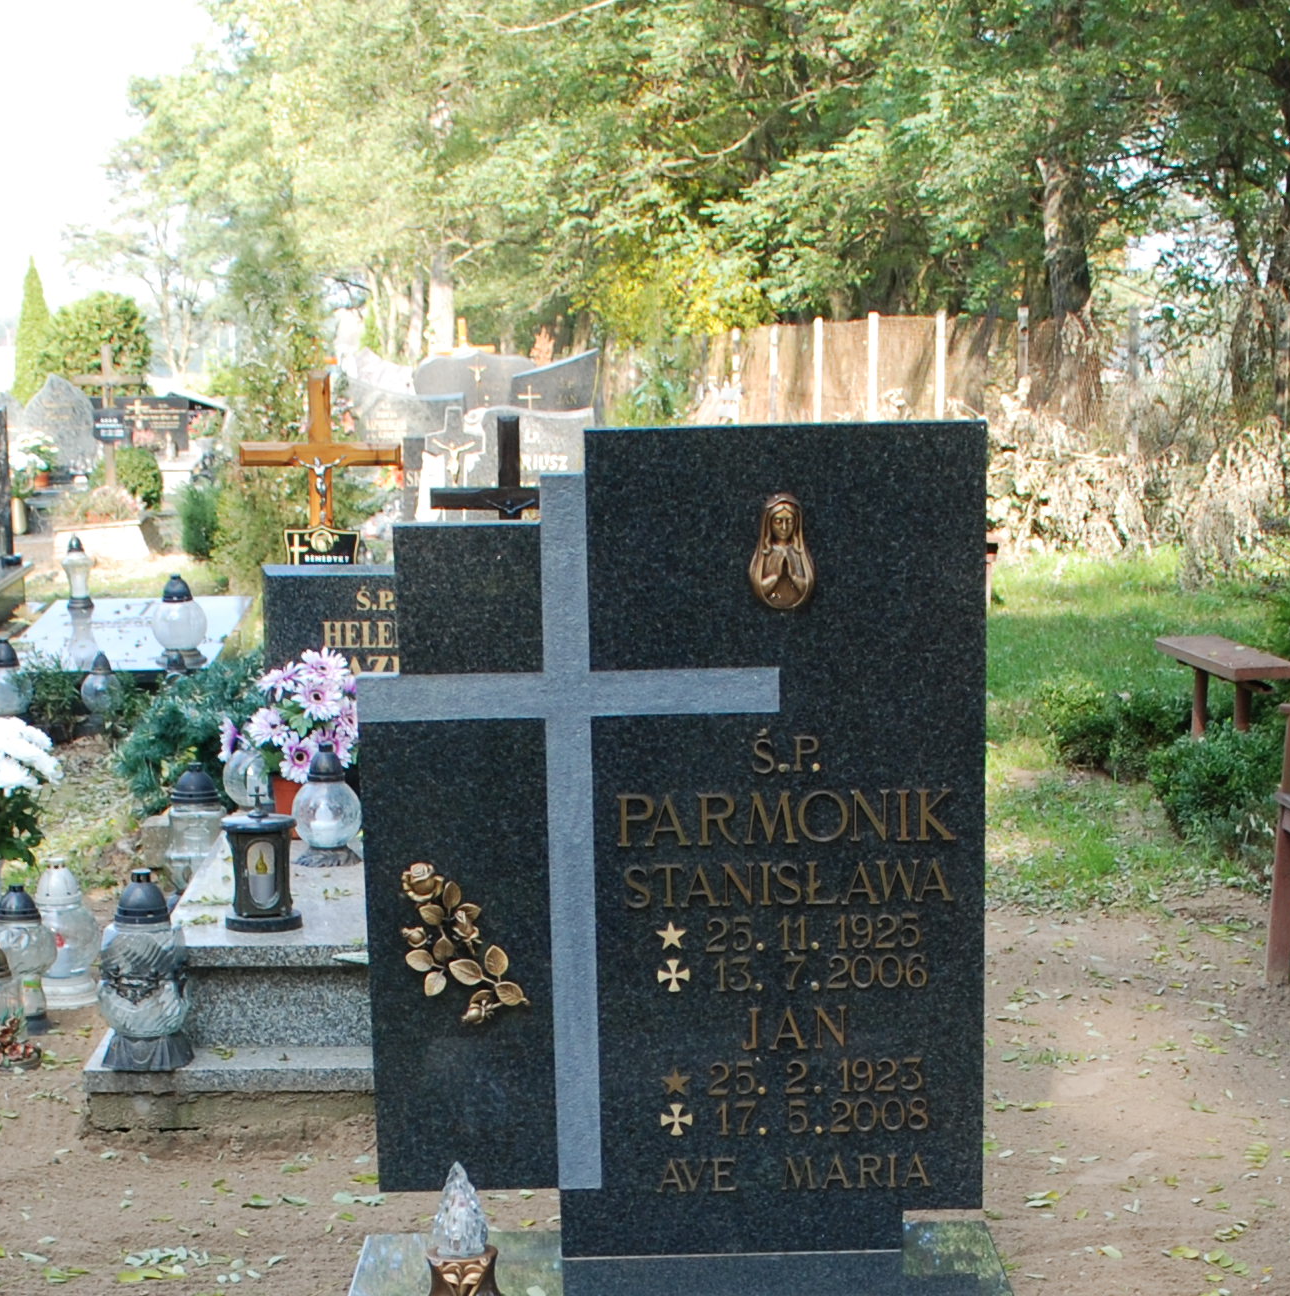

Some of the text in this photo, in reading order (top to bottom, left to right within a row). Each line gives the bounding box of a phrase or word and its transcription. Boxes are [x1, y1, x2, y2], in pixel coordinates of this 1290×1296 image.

[520, 453, 568, 471] RIUSZ
[356, 584, 397, 612] Ś.P.
[322, 620, 399, 649] HELE
[750, 727, 823, 775] Ś.P.
[616, 788, 957, 849] PARMONIK
[623, 858, 954, 910] STANISŁAWA
[742, 1005, 848, 1052] JAN
[655, 1153, 932, 1194] AVE MARIA
